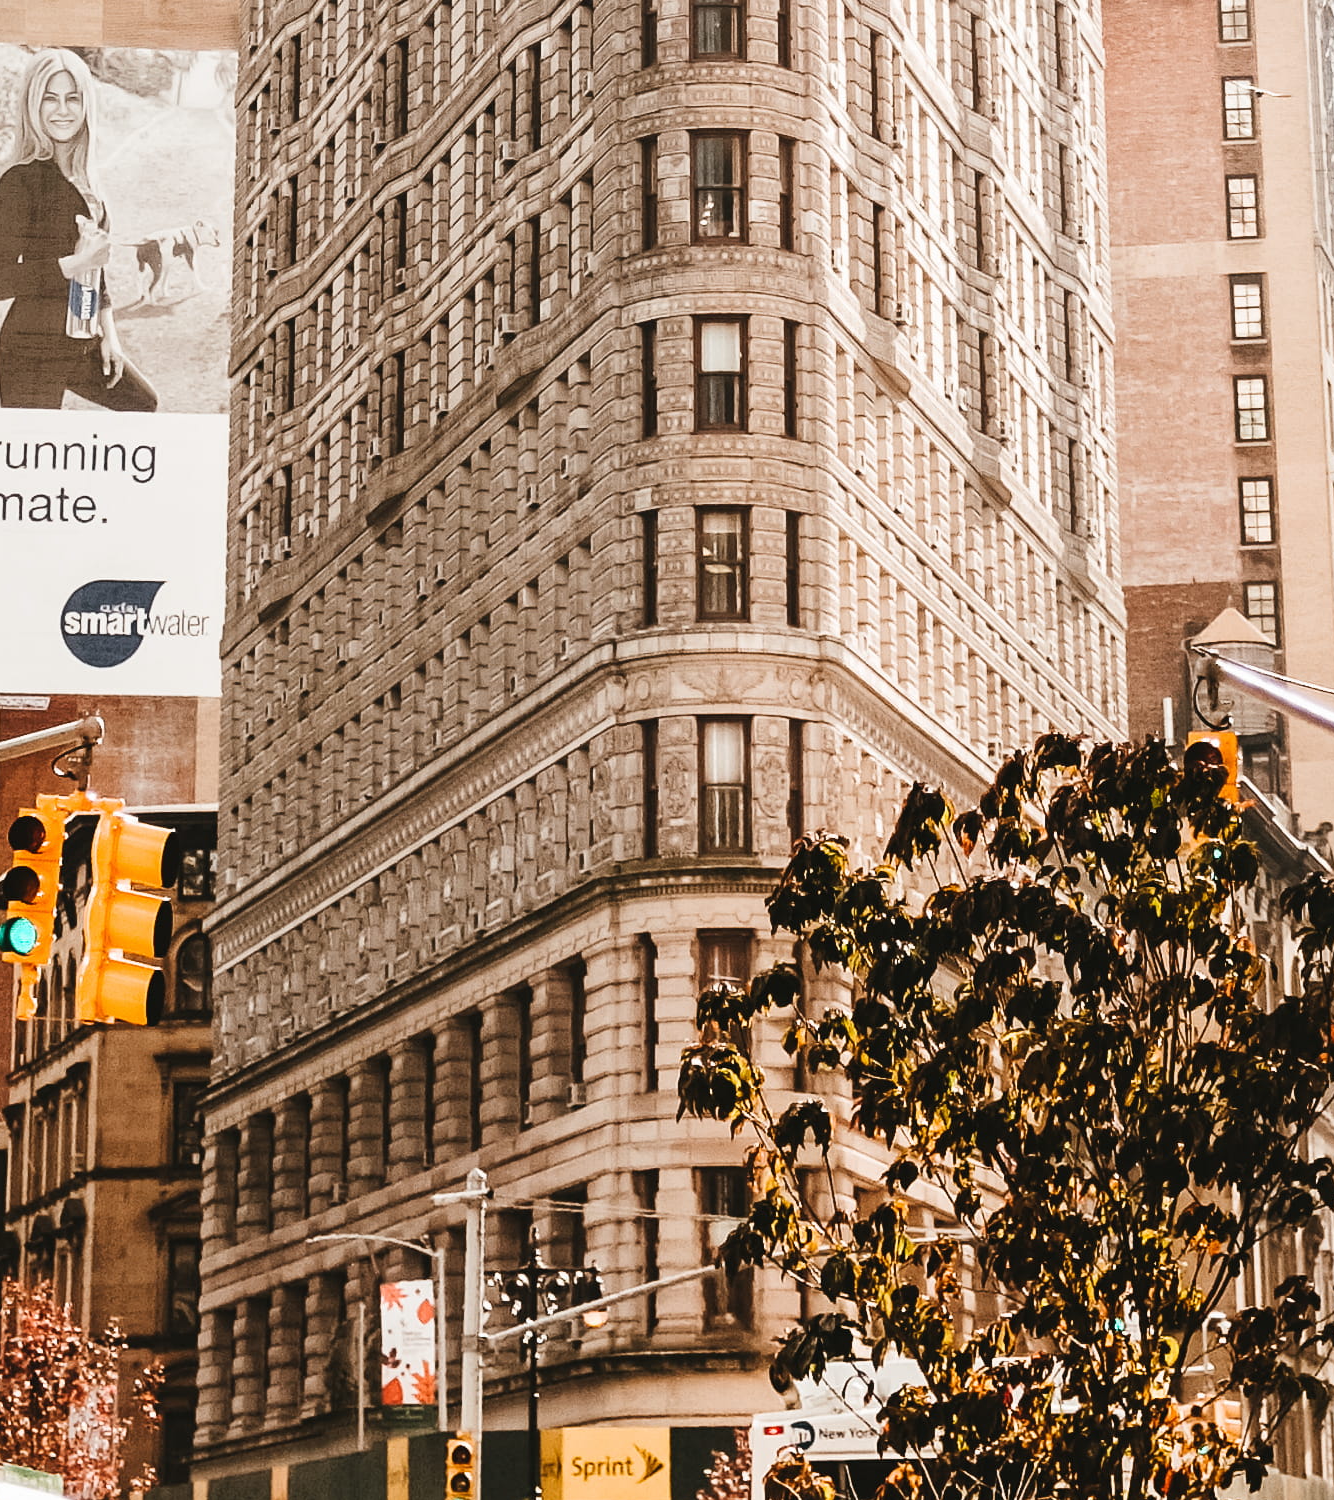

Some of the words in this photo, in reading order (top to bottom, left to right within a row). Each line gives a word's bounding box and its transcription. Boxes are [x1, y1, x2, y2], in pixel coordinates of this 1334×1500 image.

[64, 607, 209, 637] smartwater
[819, 1428, 845, 1440] New
[571, 1455, 634, 1482] Sprint
